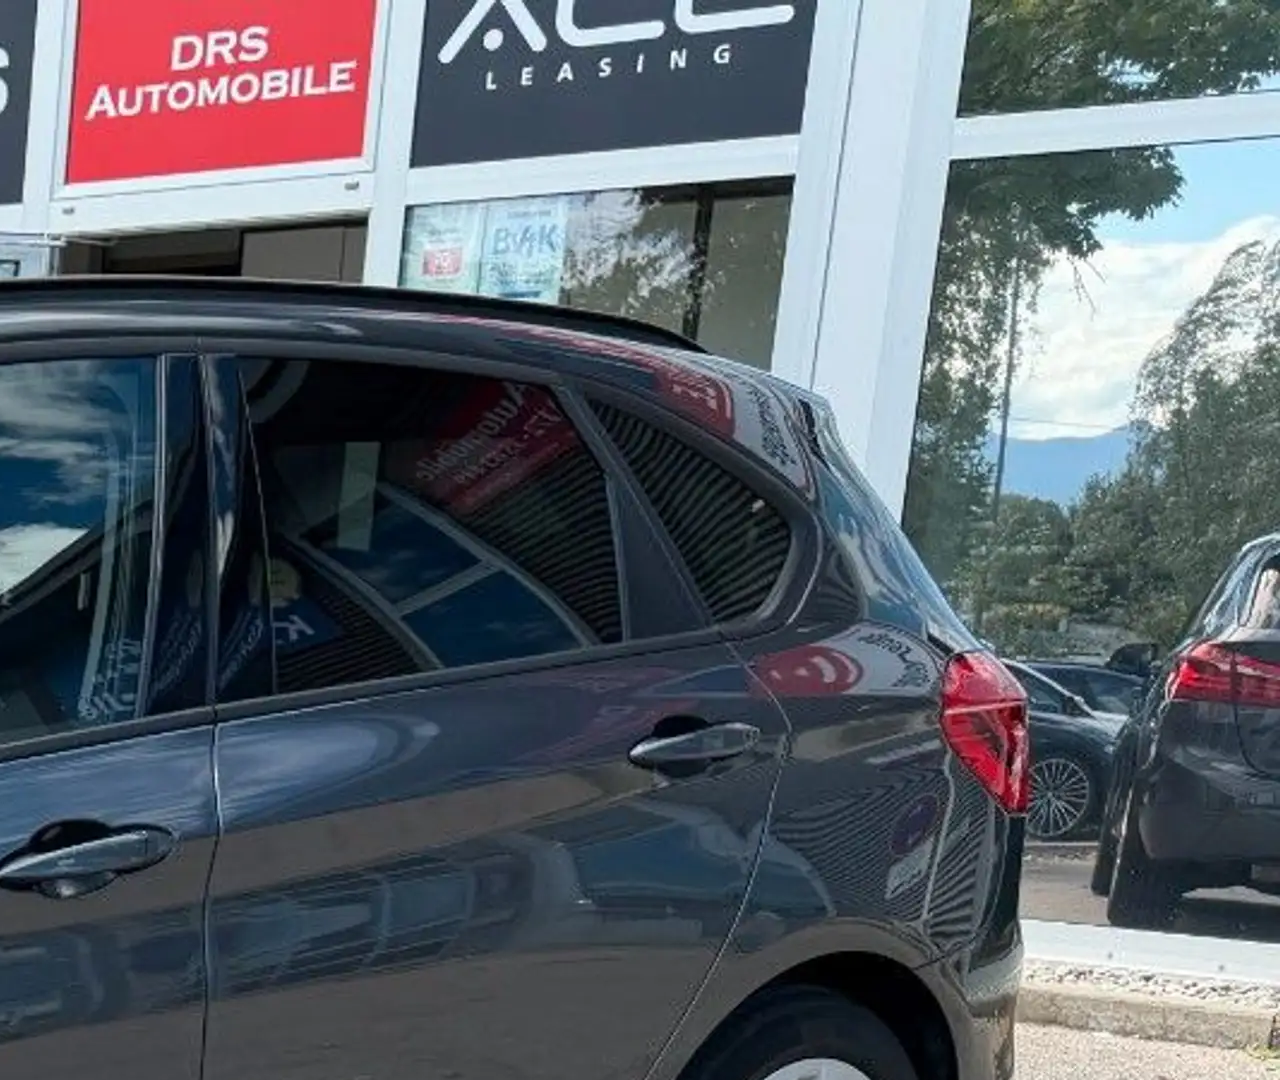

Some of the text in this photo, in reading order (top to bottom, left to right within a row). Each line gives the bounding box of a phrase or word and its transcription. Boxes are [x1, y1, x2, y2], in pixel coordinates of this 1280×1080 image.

[171, 26, 269, 71] DRS
[485, 44, 731, 90] LEASING
[84, 60, 357, 121] AUTOMOBILE
